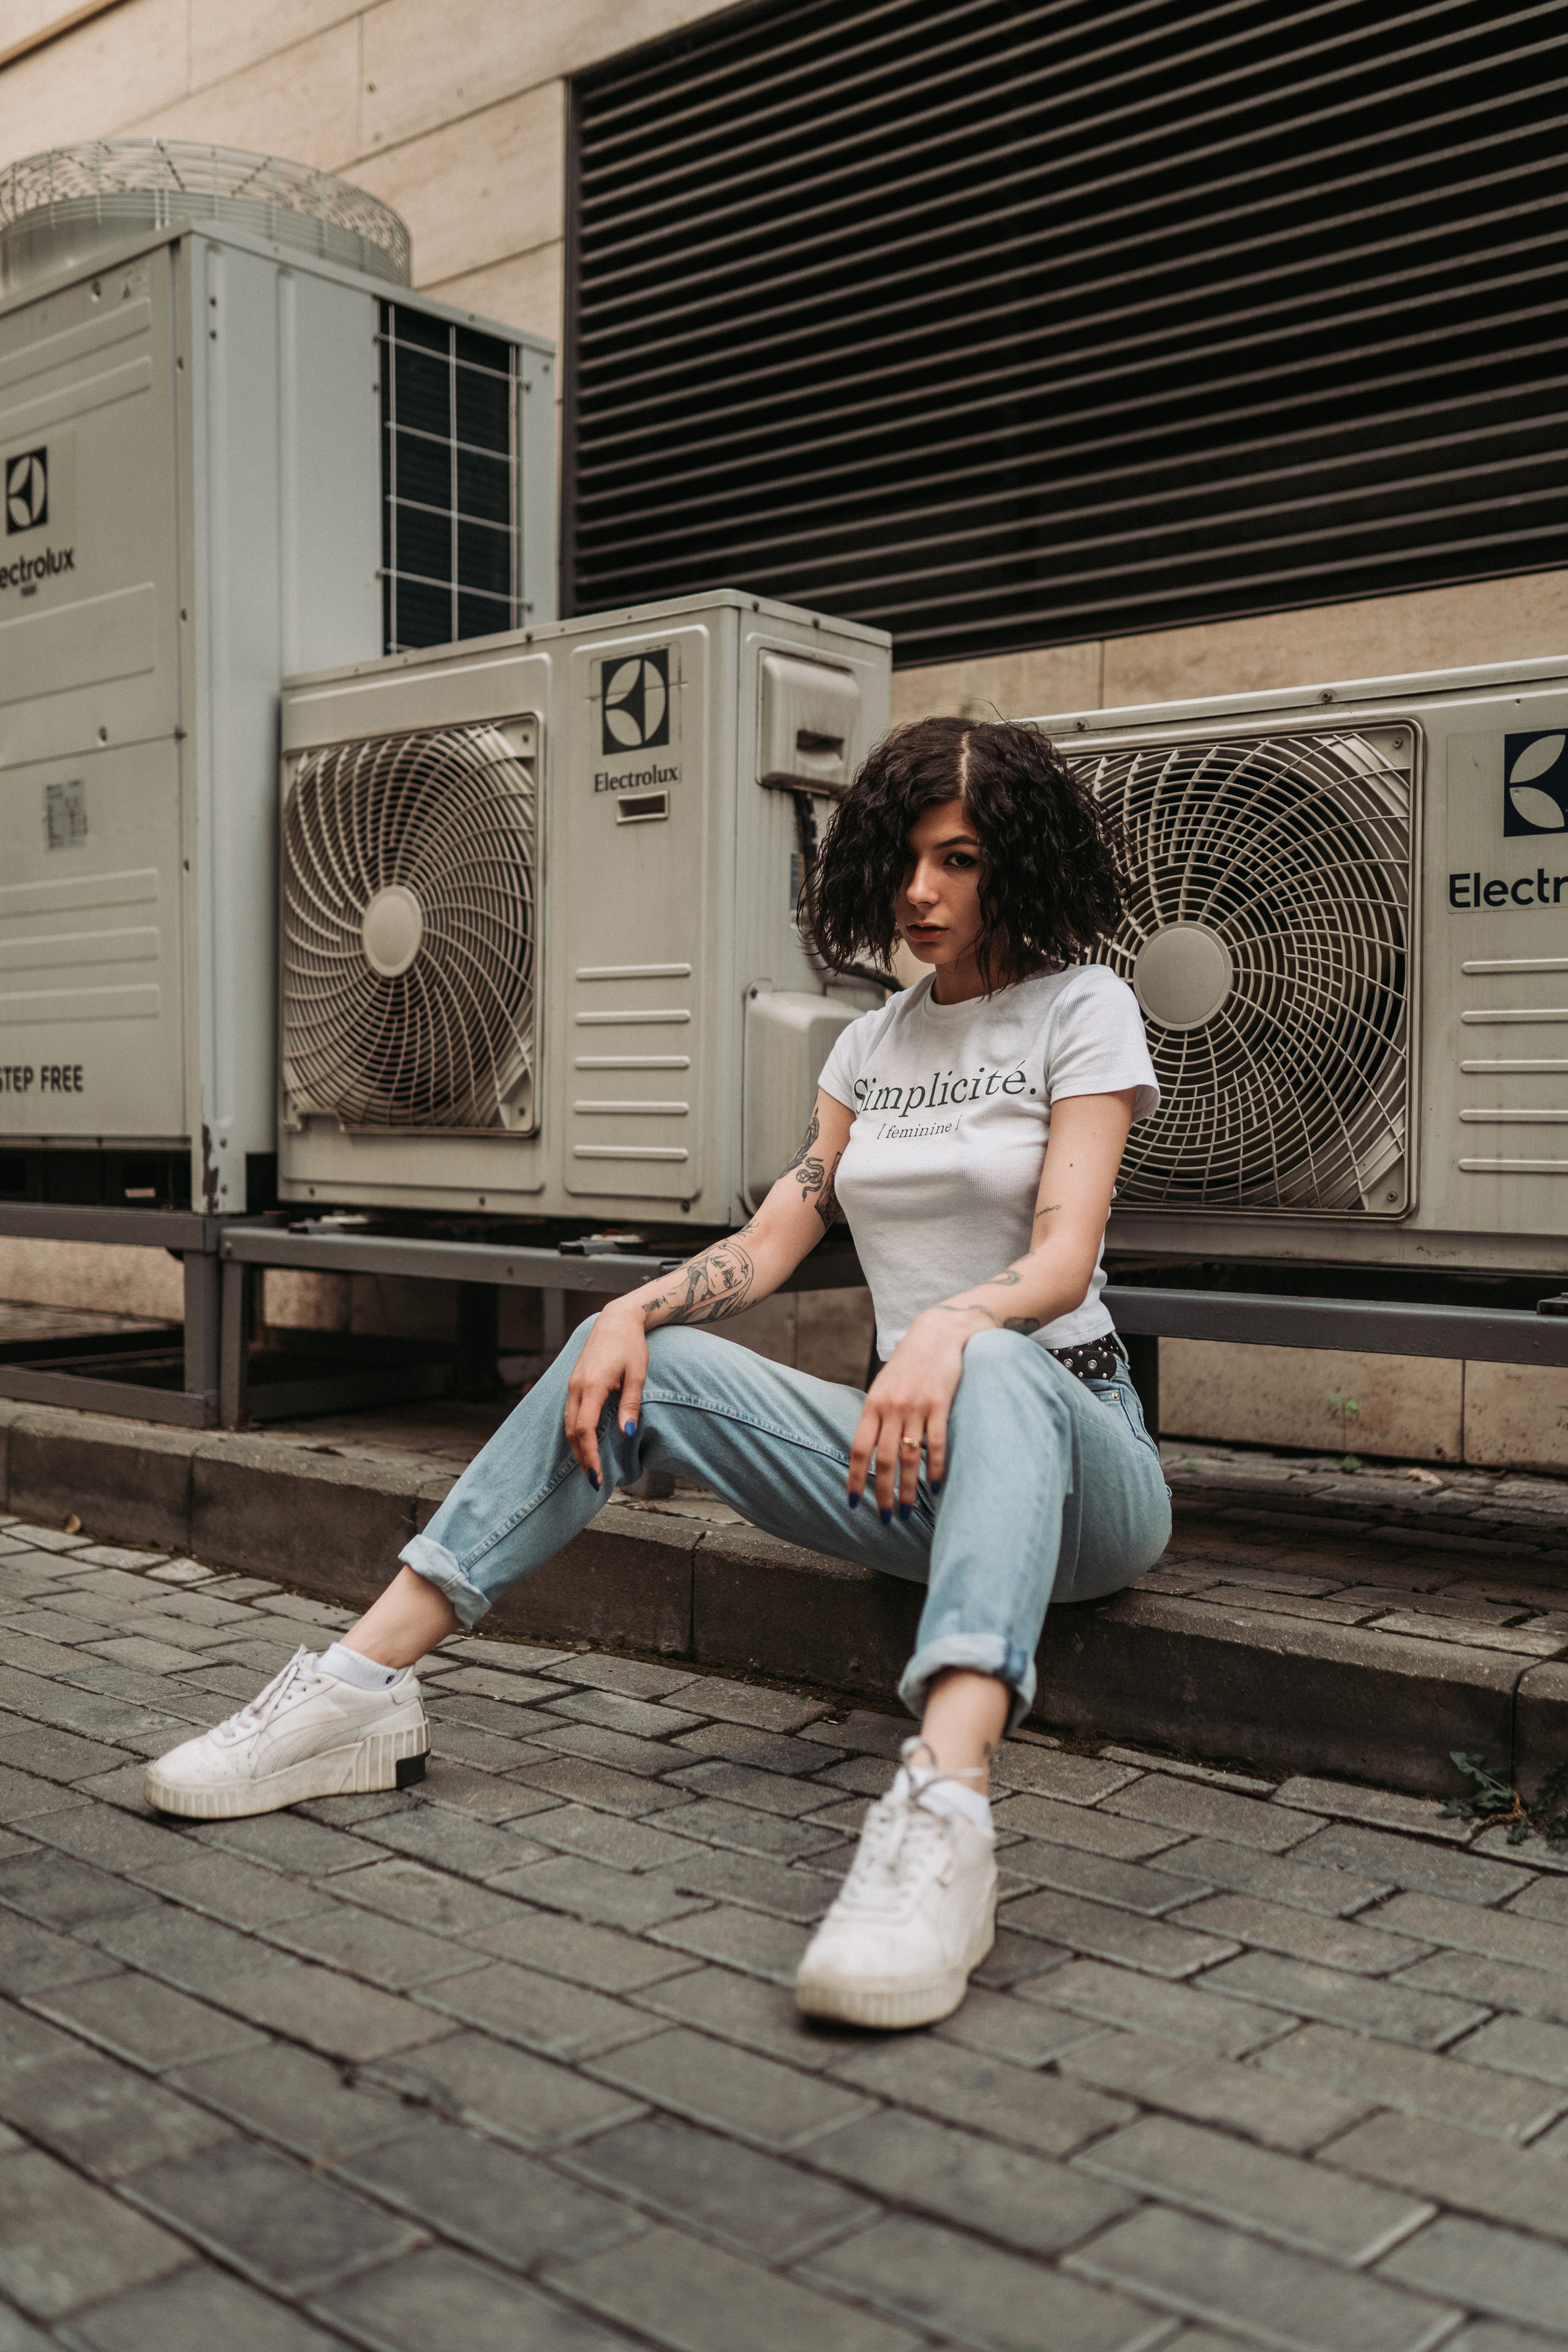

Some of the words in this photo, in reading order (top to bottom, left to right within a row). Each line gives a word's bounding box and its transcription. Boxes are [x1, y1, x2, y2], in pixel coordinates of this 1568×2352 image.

[594, 764, 678, 793] Electrolux
[1449, 868, 1568, 908] Electr
[40, 1065, 83, 1093] FREE
[854, 1060, 1036, 1117] Simplicité.
